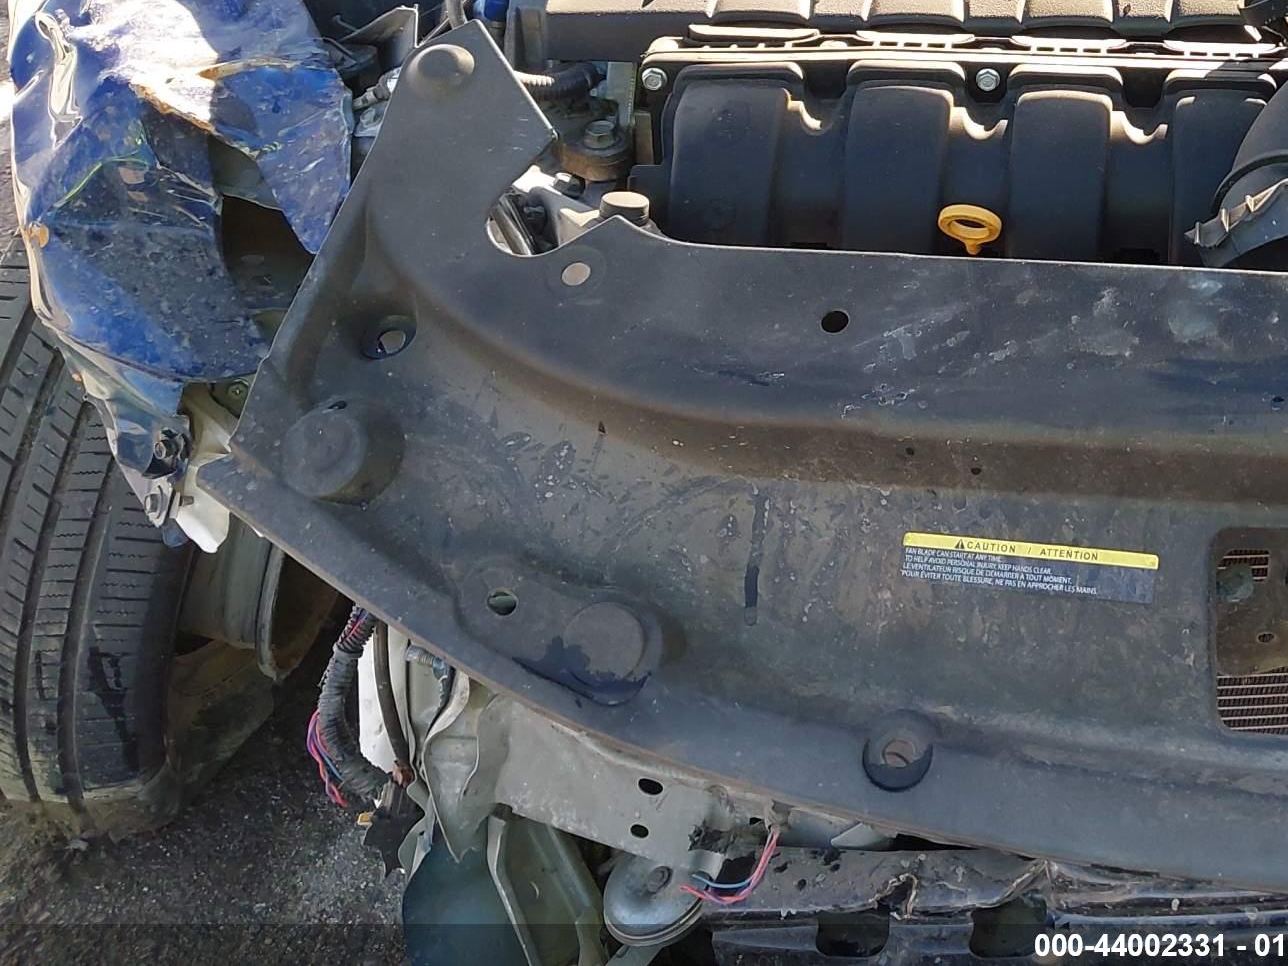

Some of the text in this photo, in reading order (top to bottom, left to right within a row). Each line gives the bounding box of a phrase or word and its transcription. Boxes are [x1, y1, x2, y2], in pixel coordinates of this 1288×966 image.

[905, 547, 917, 555] FAN
[918, 548, 936, 556] BLADE
[936, 549, 949, 557] CAN
[967, 552, 975, 560] AT
[975, 553, 987, 561] ANY
[967, 541, 1016, 553] CAUTION
[1040, 548, 1098, 560] ATTENTION
[905, 554, 913, 562] TO
[913, 555, 928, 563] HELP
[928, 557, 946, 565] AVOID
[947, 559, 976, 568] PERSONAL
[998, 563, 1012, 571] KEEP
[1012, 564, 1032, 573] HANDS
[901, 569, 919, 578] POUR
[942, 573, 962, 582] TOUTE
[994, 578, 1004, 586] NE
[1004, 579, 1017, 587] PAS
[1017, 580, 1026, 588] EN
[1027, 581, 1064, 592] APPROCHER
[1064, 584, 1076, 593] LES
[903, 562, 911, 570] LE
[911, 563, 951, 573] VENTILATEUR
[952, 566, 975, 575] RISQUE
[1025, 573, 1042, 582] TOUT
[1043, 575, 1072, 585] MOMENT.
